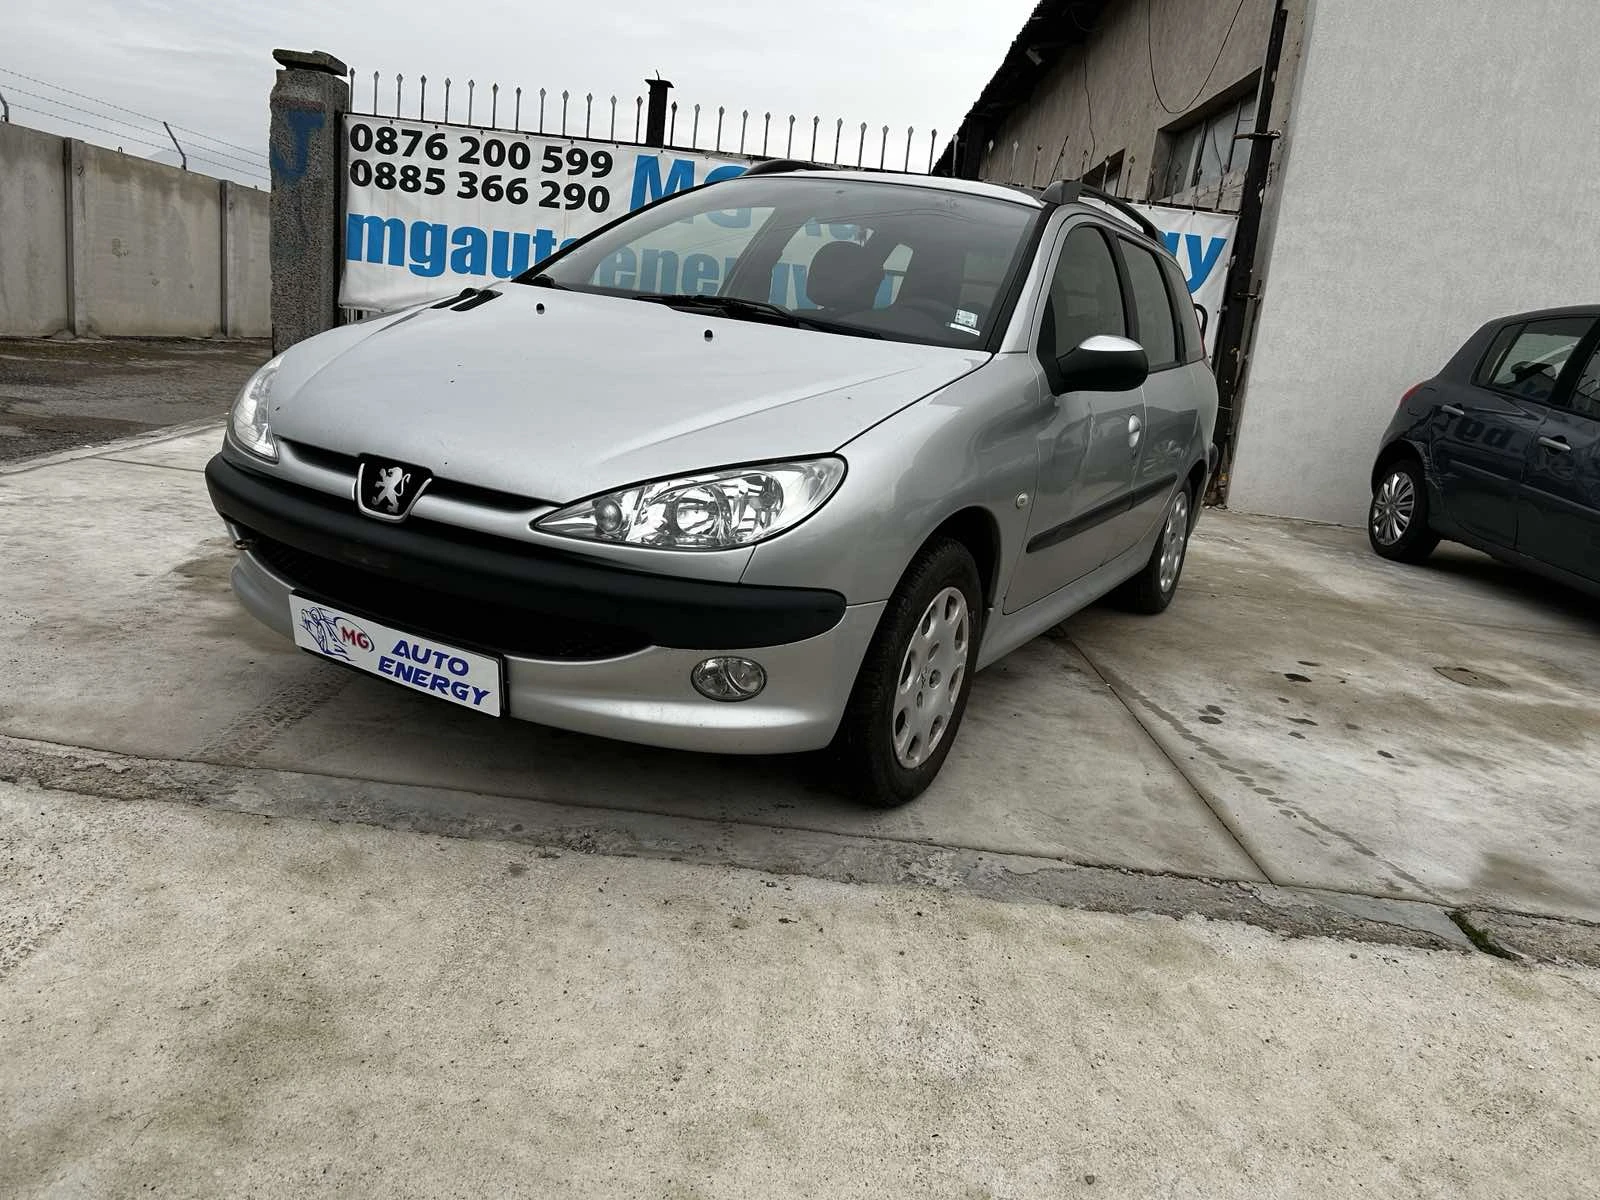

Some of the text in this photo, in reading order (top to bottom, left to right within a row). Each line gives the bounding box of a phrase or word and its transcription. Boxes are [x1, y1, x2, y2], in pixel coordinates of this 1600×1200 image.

[350, 123, 613, 178] 0876 200 599
[350, 159, 610, 213] 0885 366 290
[341, 625, 369, 649] MG
[391, 640, 469, 677] AUTO
[378, 655, 491, 706] ENERGY
